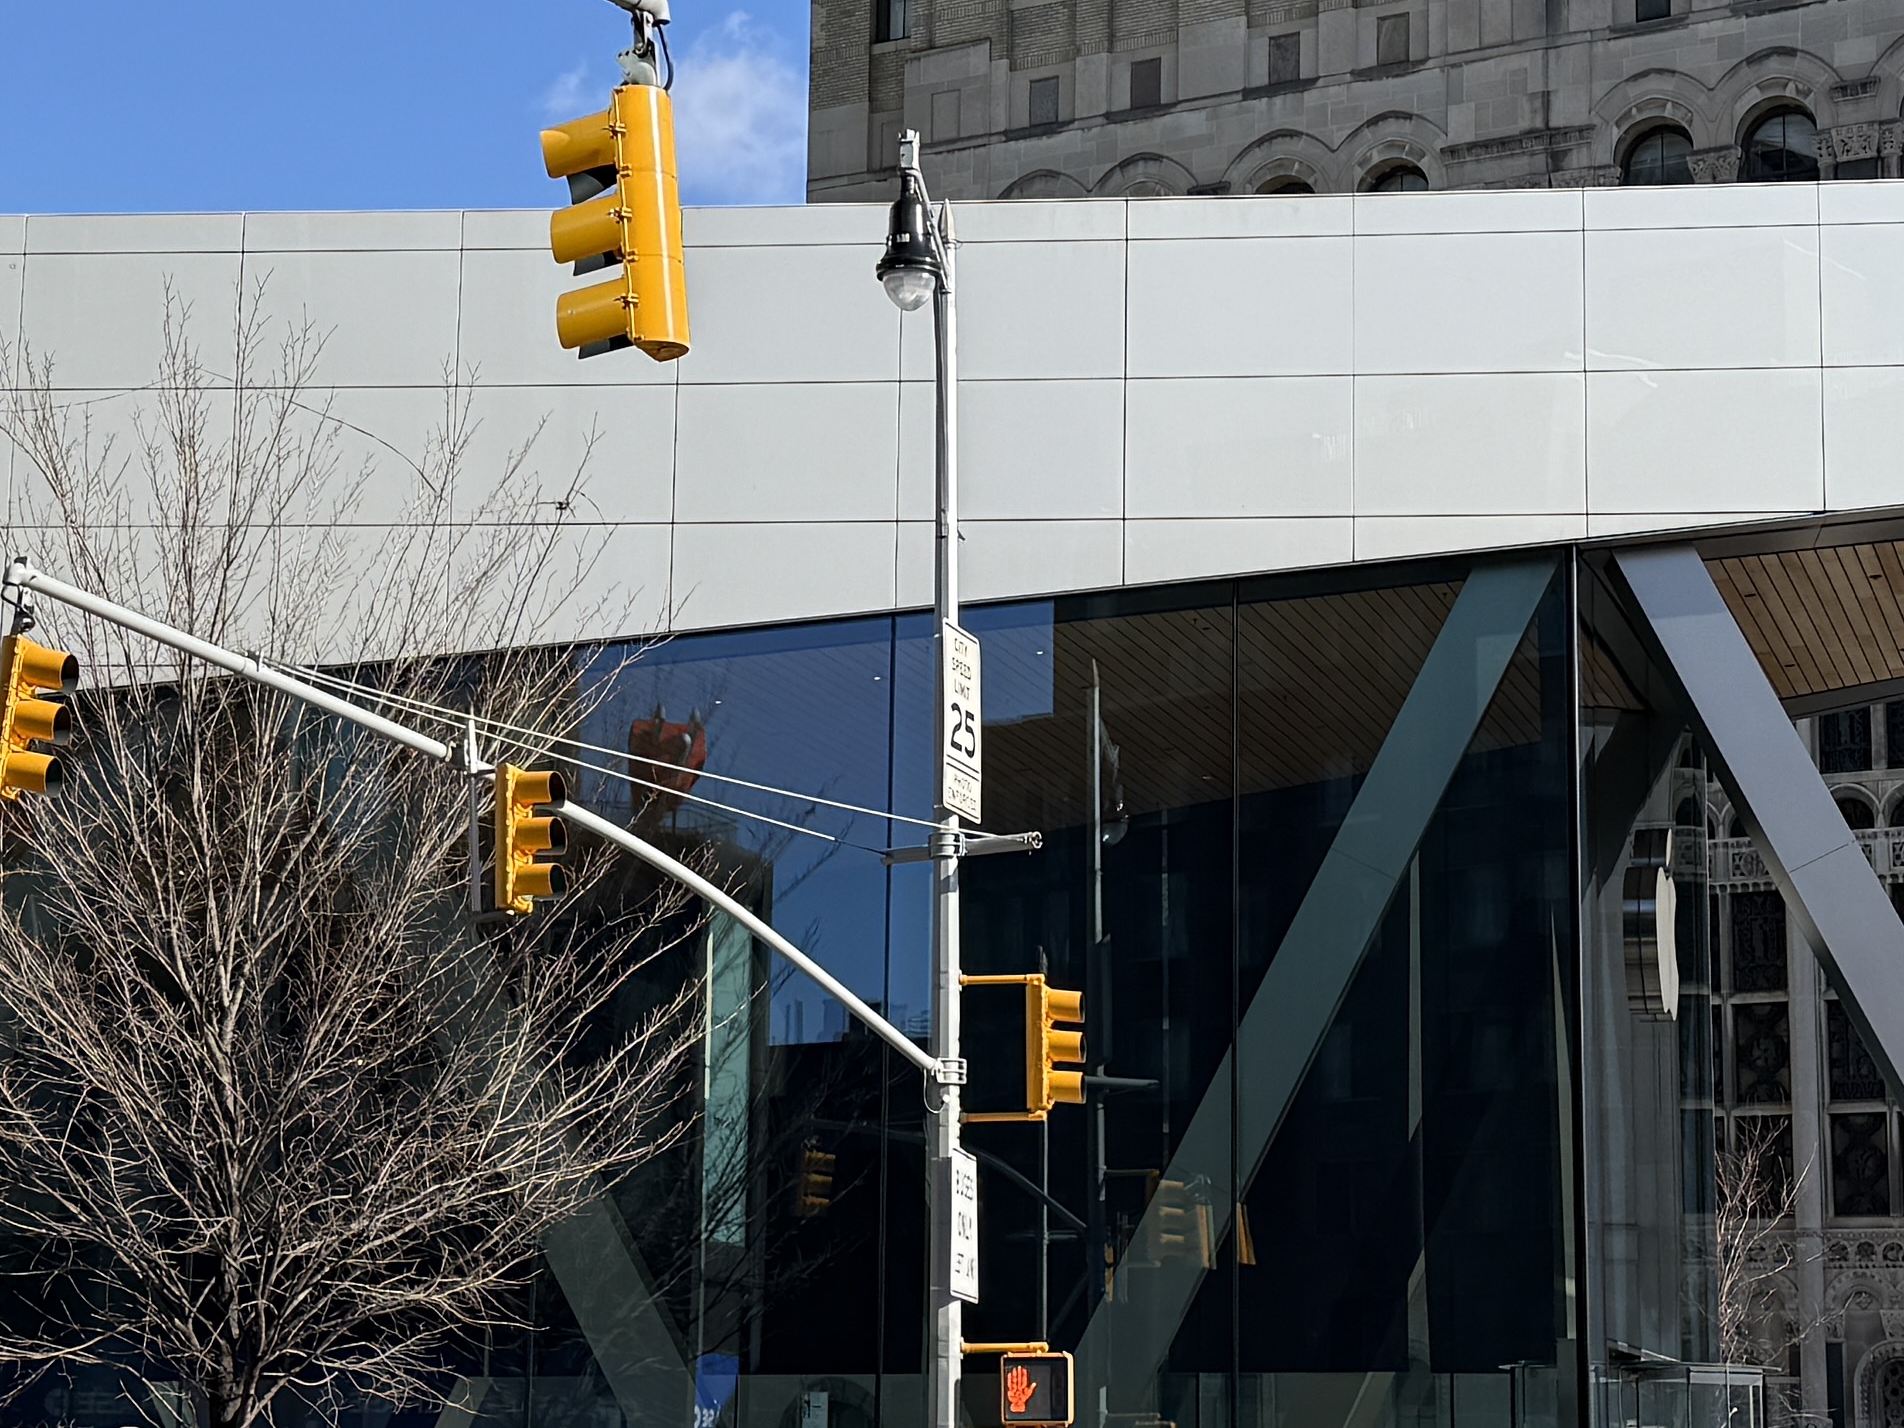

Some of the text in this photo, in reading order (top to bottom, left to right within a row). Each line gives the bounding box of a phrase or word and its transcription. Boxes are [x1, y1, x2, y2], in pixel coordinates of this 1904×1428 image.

[955, 638, 969, 658] CITY
[952, 657, 972, 681] SPEED
[954, 679, 970, 700] LIMIT
[951, 702, 976, 759] 25
